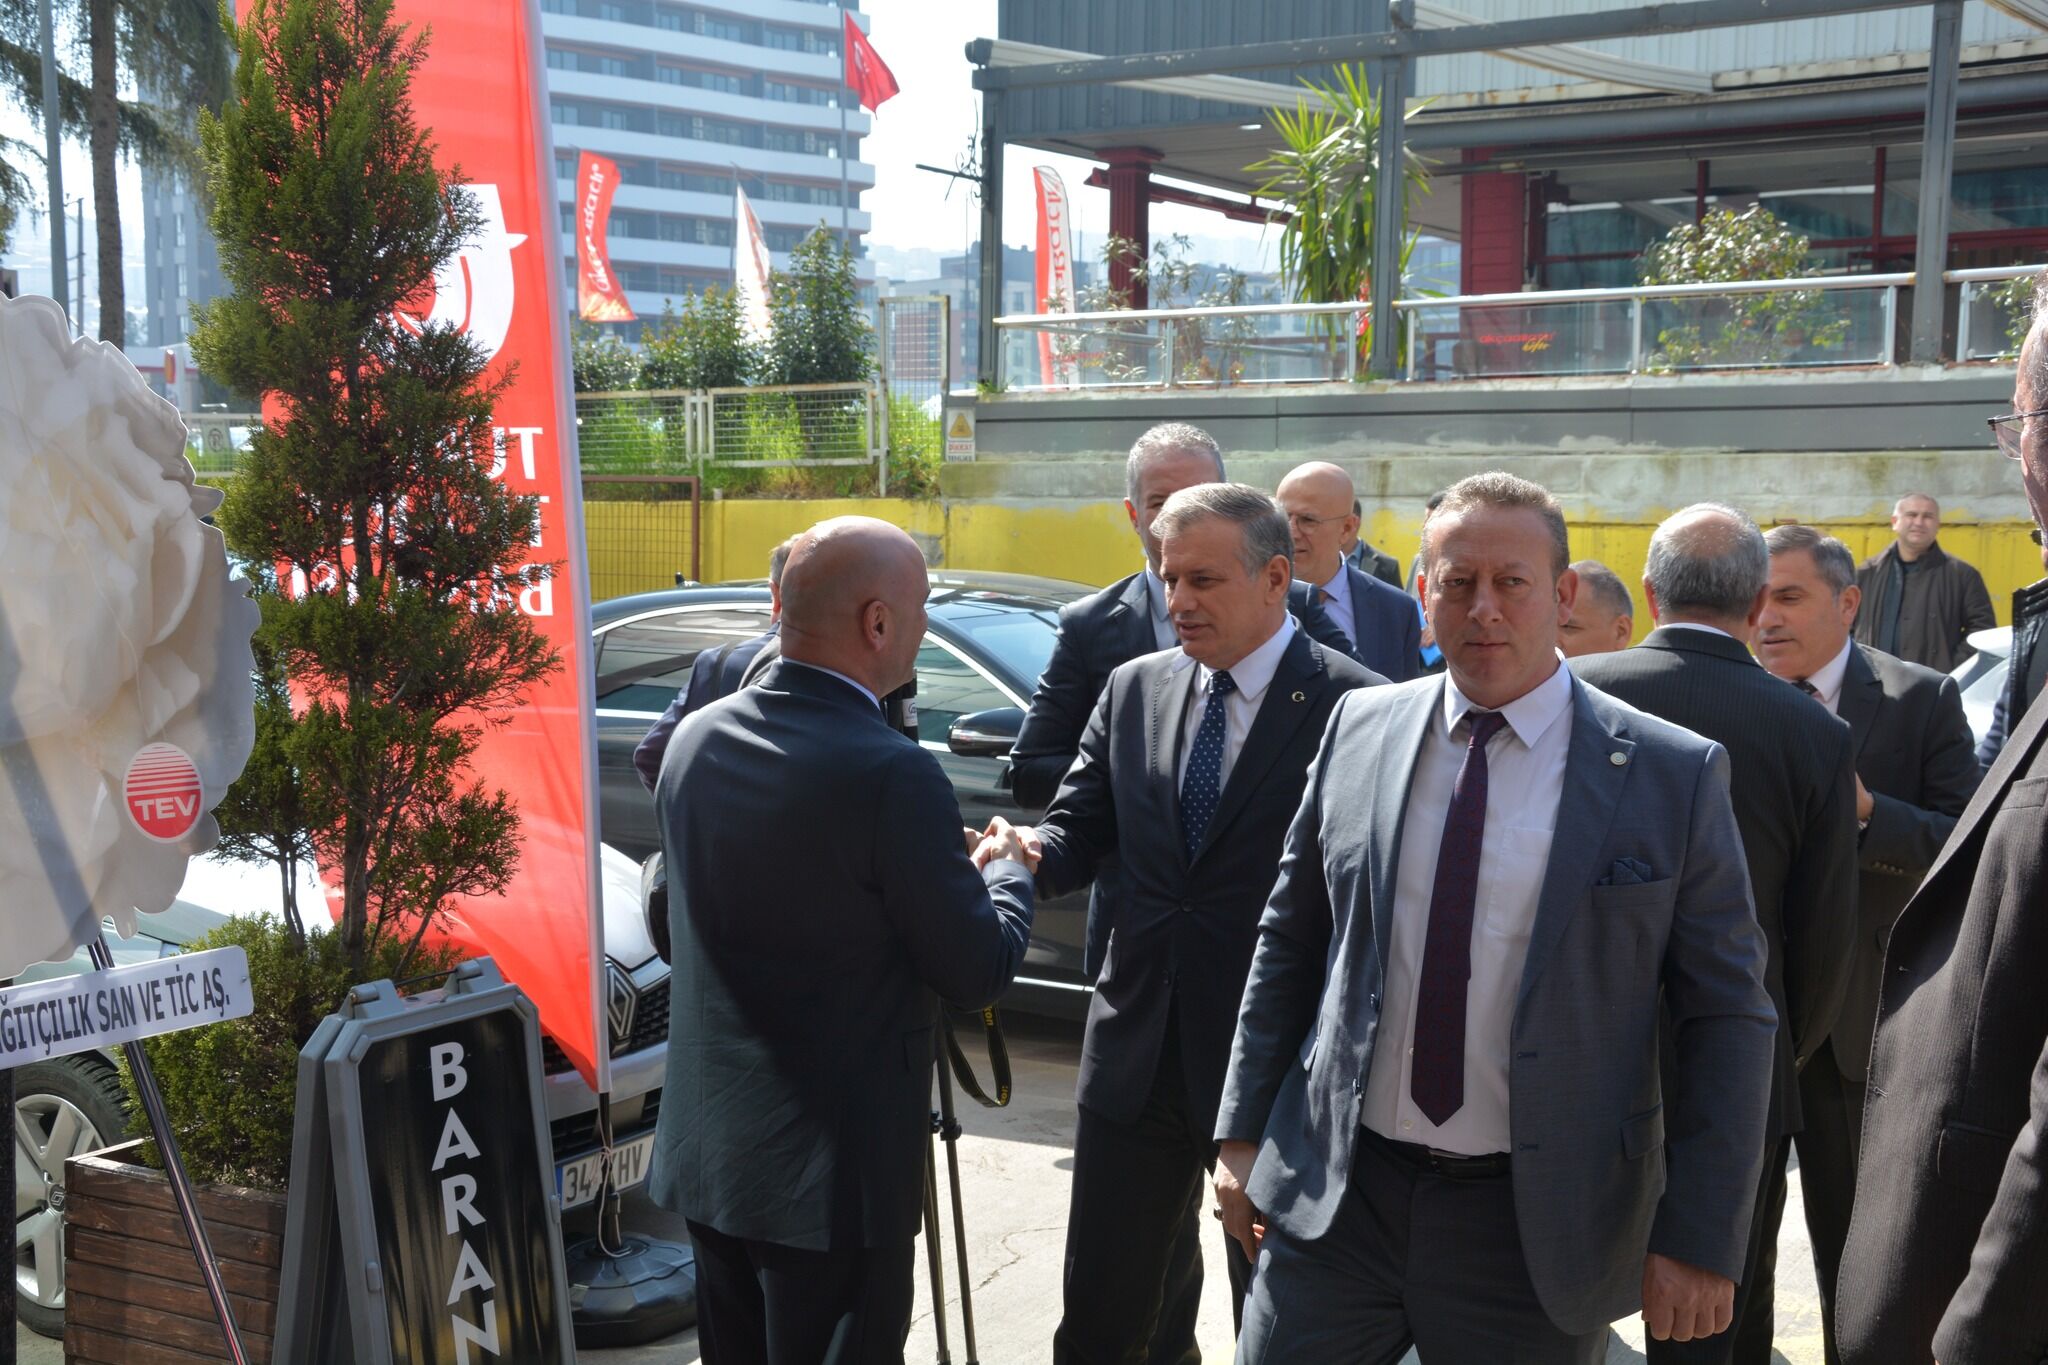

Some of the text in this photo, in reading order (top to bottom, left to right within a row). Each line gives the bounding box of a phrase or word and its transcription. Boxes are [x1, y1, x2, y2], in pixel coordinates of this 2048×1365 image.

[134, 794, 197, 821] TEV
[0, 964, 230, 1055] ĞITÇILIK SAN VE TİC AŞ.
[430, 1041, 501, 1365] BARAN
[566, 1162, 593, 1203] 34
